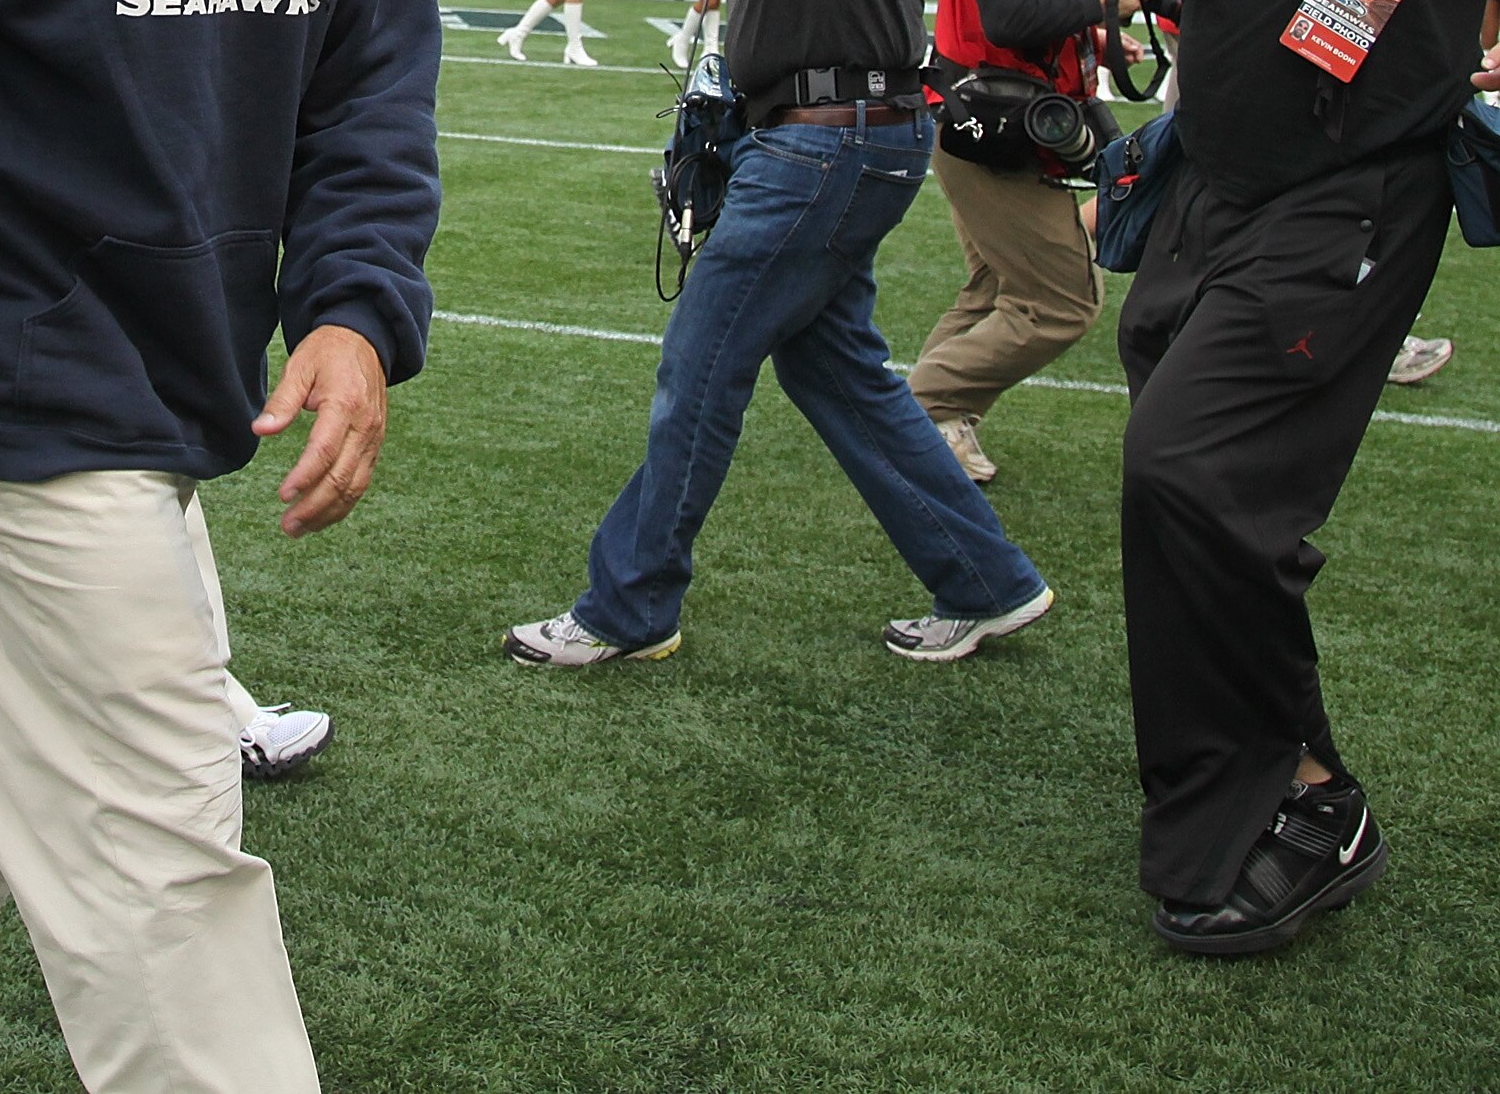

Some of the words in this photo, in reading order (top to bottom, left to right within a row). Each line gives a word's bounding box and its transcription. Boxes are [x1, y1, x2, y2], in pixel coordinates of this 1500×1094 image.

[1301, 3, 1333, 27] FIELD
[1332, 22, 1370, 49] PHOTO
[1311, 34, 1334, 52] KEVIN
[1332, 48, 1357, 66] BODHI
